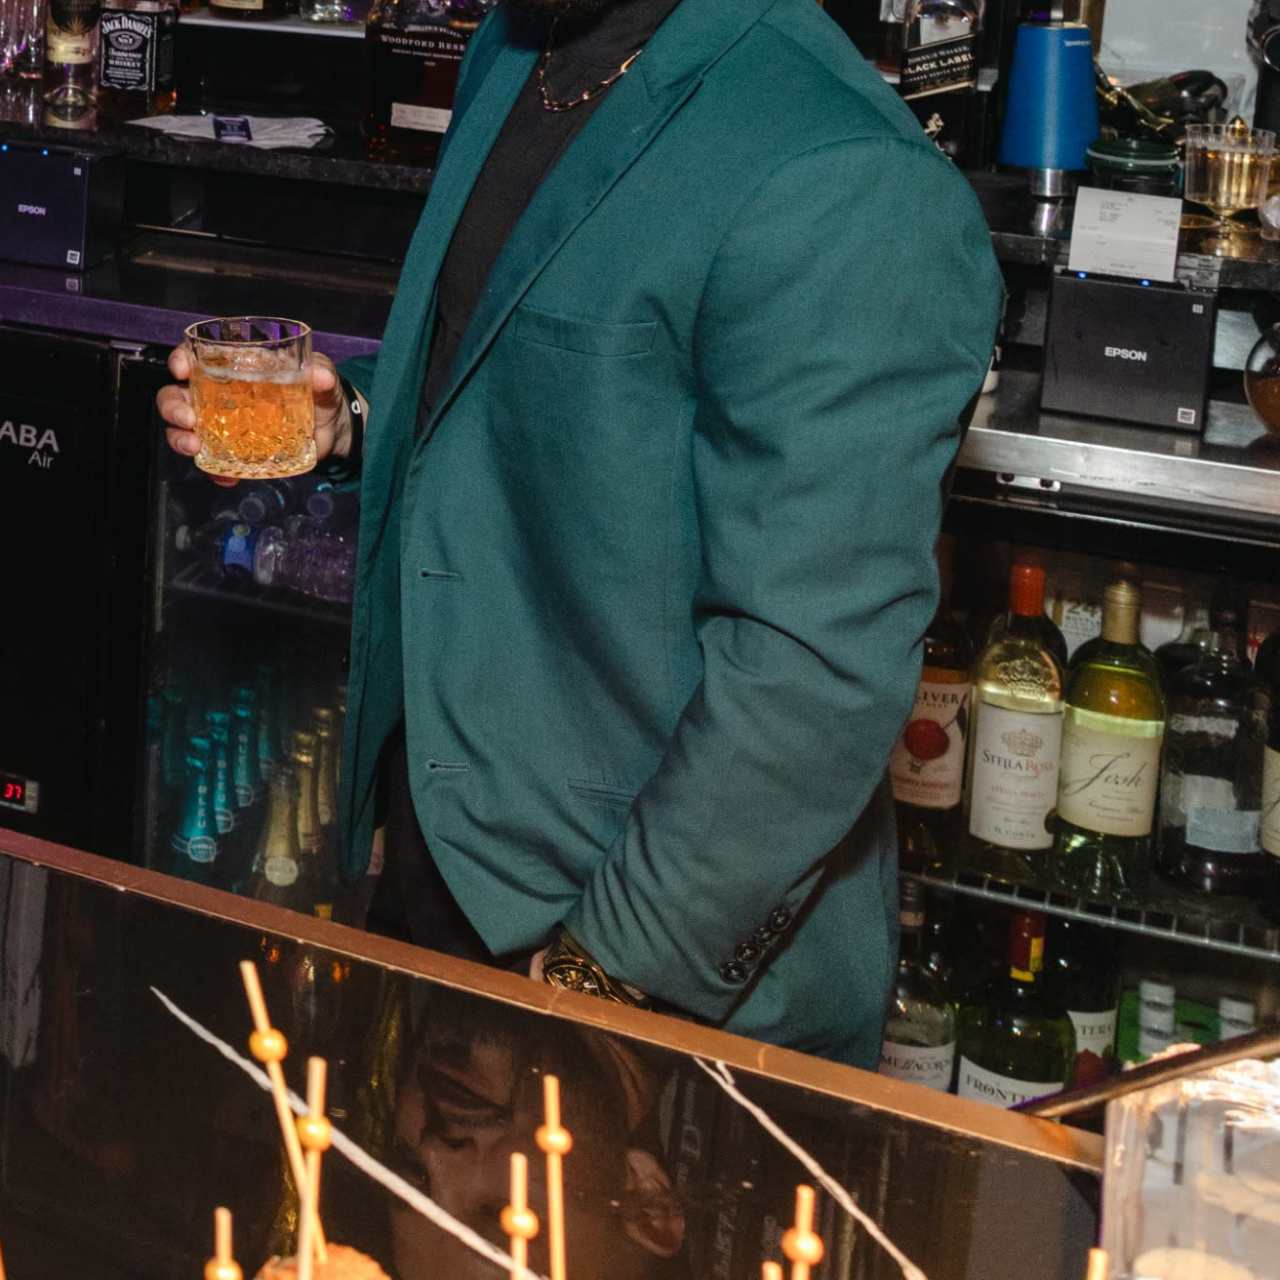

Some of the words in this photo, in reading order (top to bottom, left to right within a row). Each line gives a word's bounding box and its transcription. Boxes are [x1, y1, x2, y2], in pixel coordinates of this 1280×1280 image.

[380, 34, 436, 48] WOODFORD
[940, 53, 975, 66] LABEL
[18, 204, 46, 216] EPSON
[1104, 346, 1147, 362] EPSON
[27, 450, 54, 468] Air
[983, 750, 1023, 771] STELLA
[4, 783, 22, 800] 37
